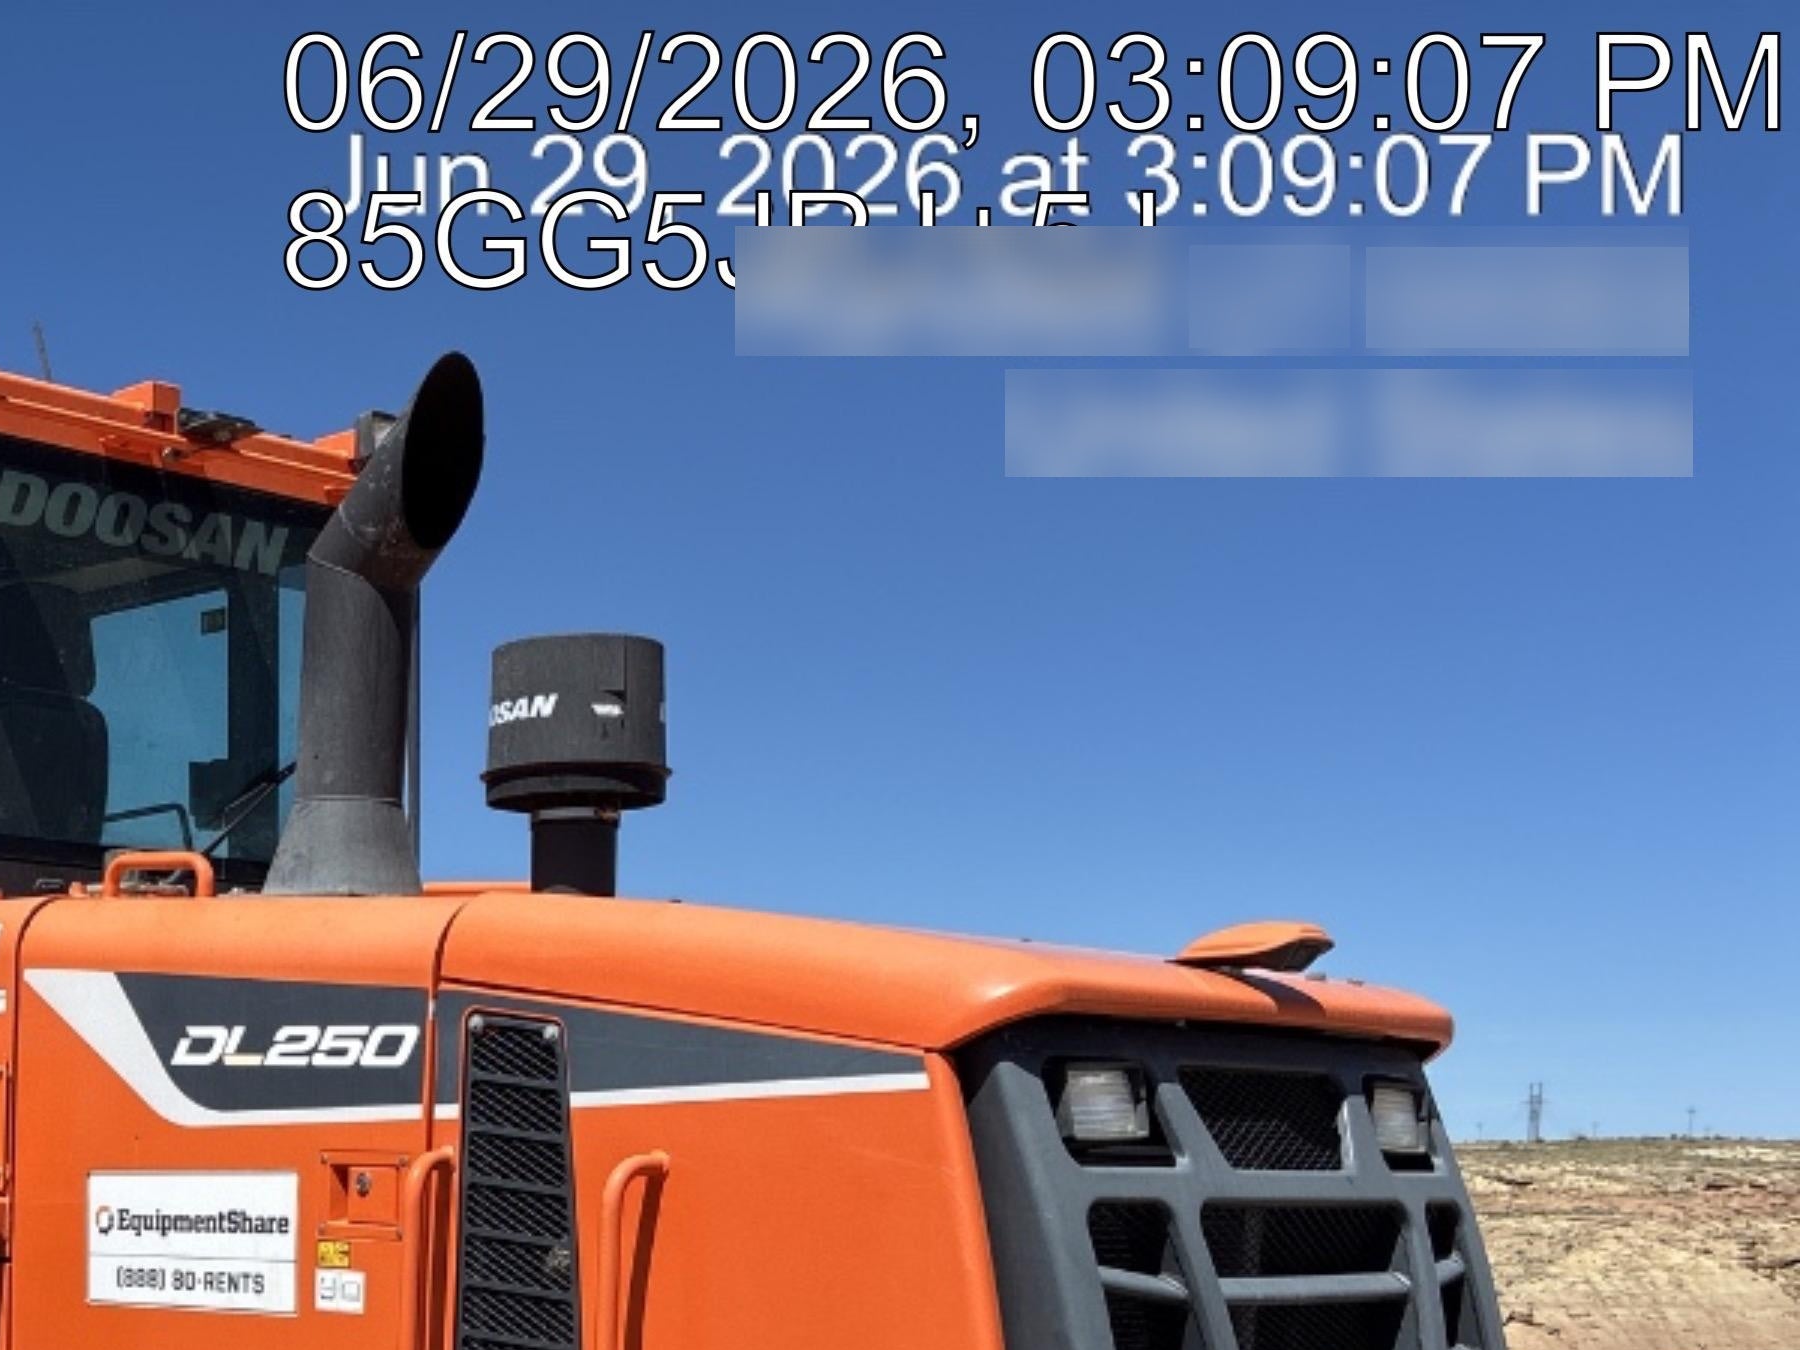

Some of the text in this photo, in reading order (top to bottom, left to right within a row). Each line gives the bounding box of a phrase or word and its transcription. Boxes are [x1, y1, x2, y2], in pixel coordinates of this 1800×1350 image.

[170, 1024, 420, 1067] DL250
[117, 1208, 289, 1237] EquipmentShare
[117, 1266, 166, 1290] (888)
